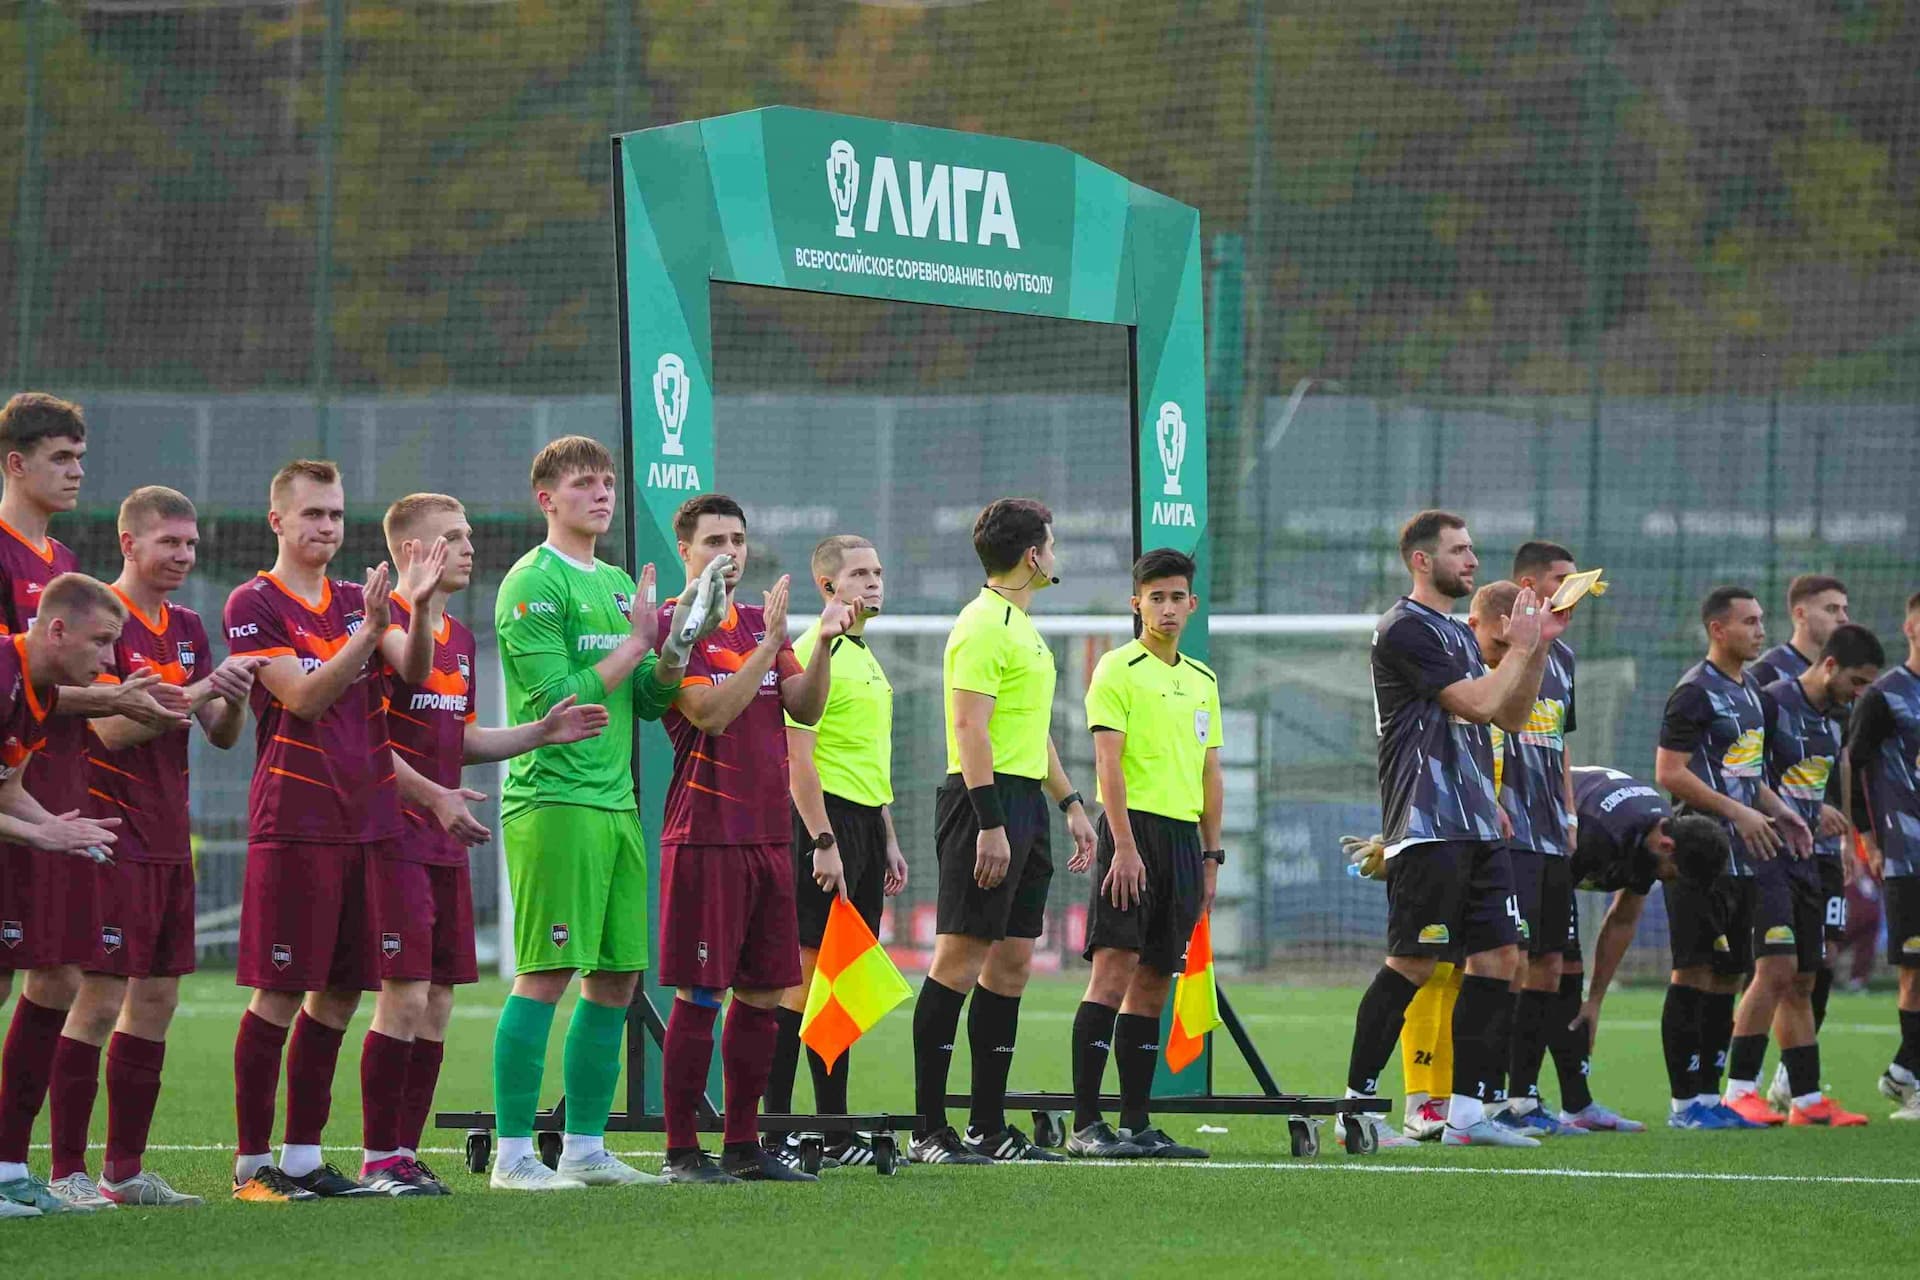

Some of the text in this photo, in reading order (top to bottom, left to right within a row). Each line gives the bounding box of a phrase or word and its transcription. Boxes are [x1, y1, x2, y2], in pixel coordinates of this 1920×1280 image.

[864, 156, 1021, 249] ЛИГА
[795, 247, 1054, 295] ВСЕРОССИЙСКОЕ СОРЕВНОВАНИЕ ПО ФУТБОЛУ
[647, 462, 701, 491] ЛИГА
[1151, 501, 1196, 527] ЛИГА
[229, 623, 258, 638] ПСБ
